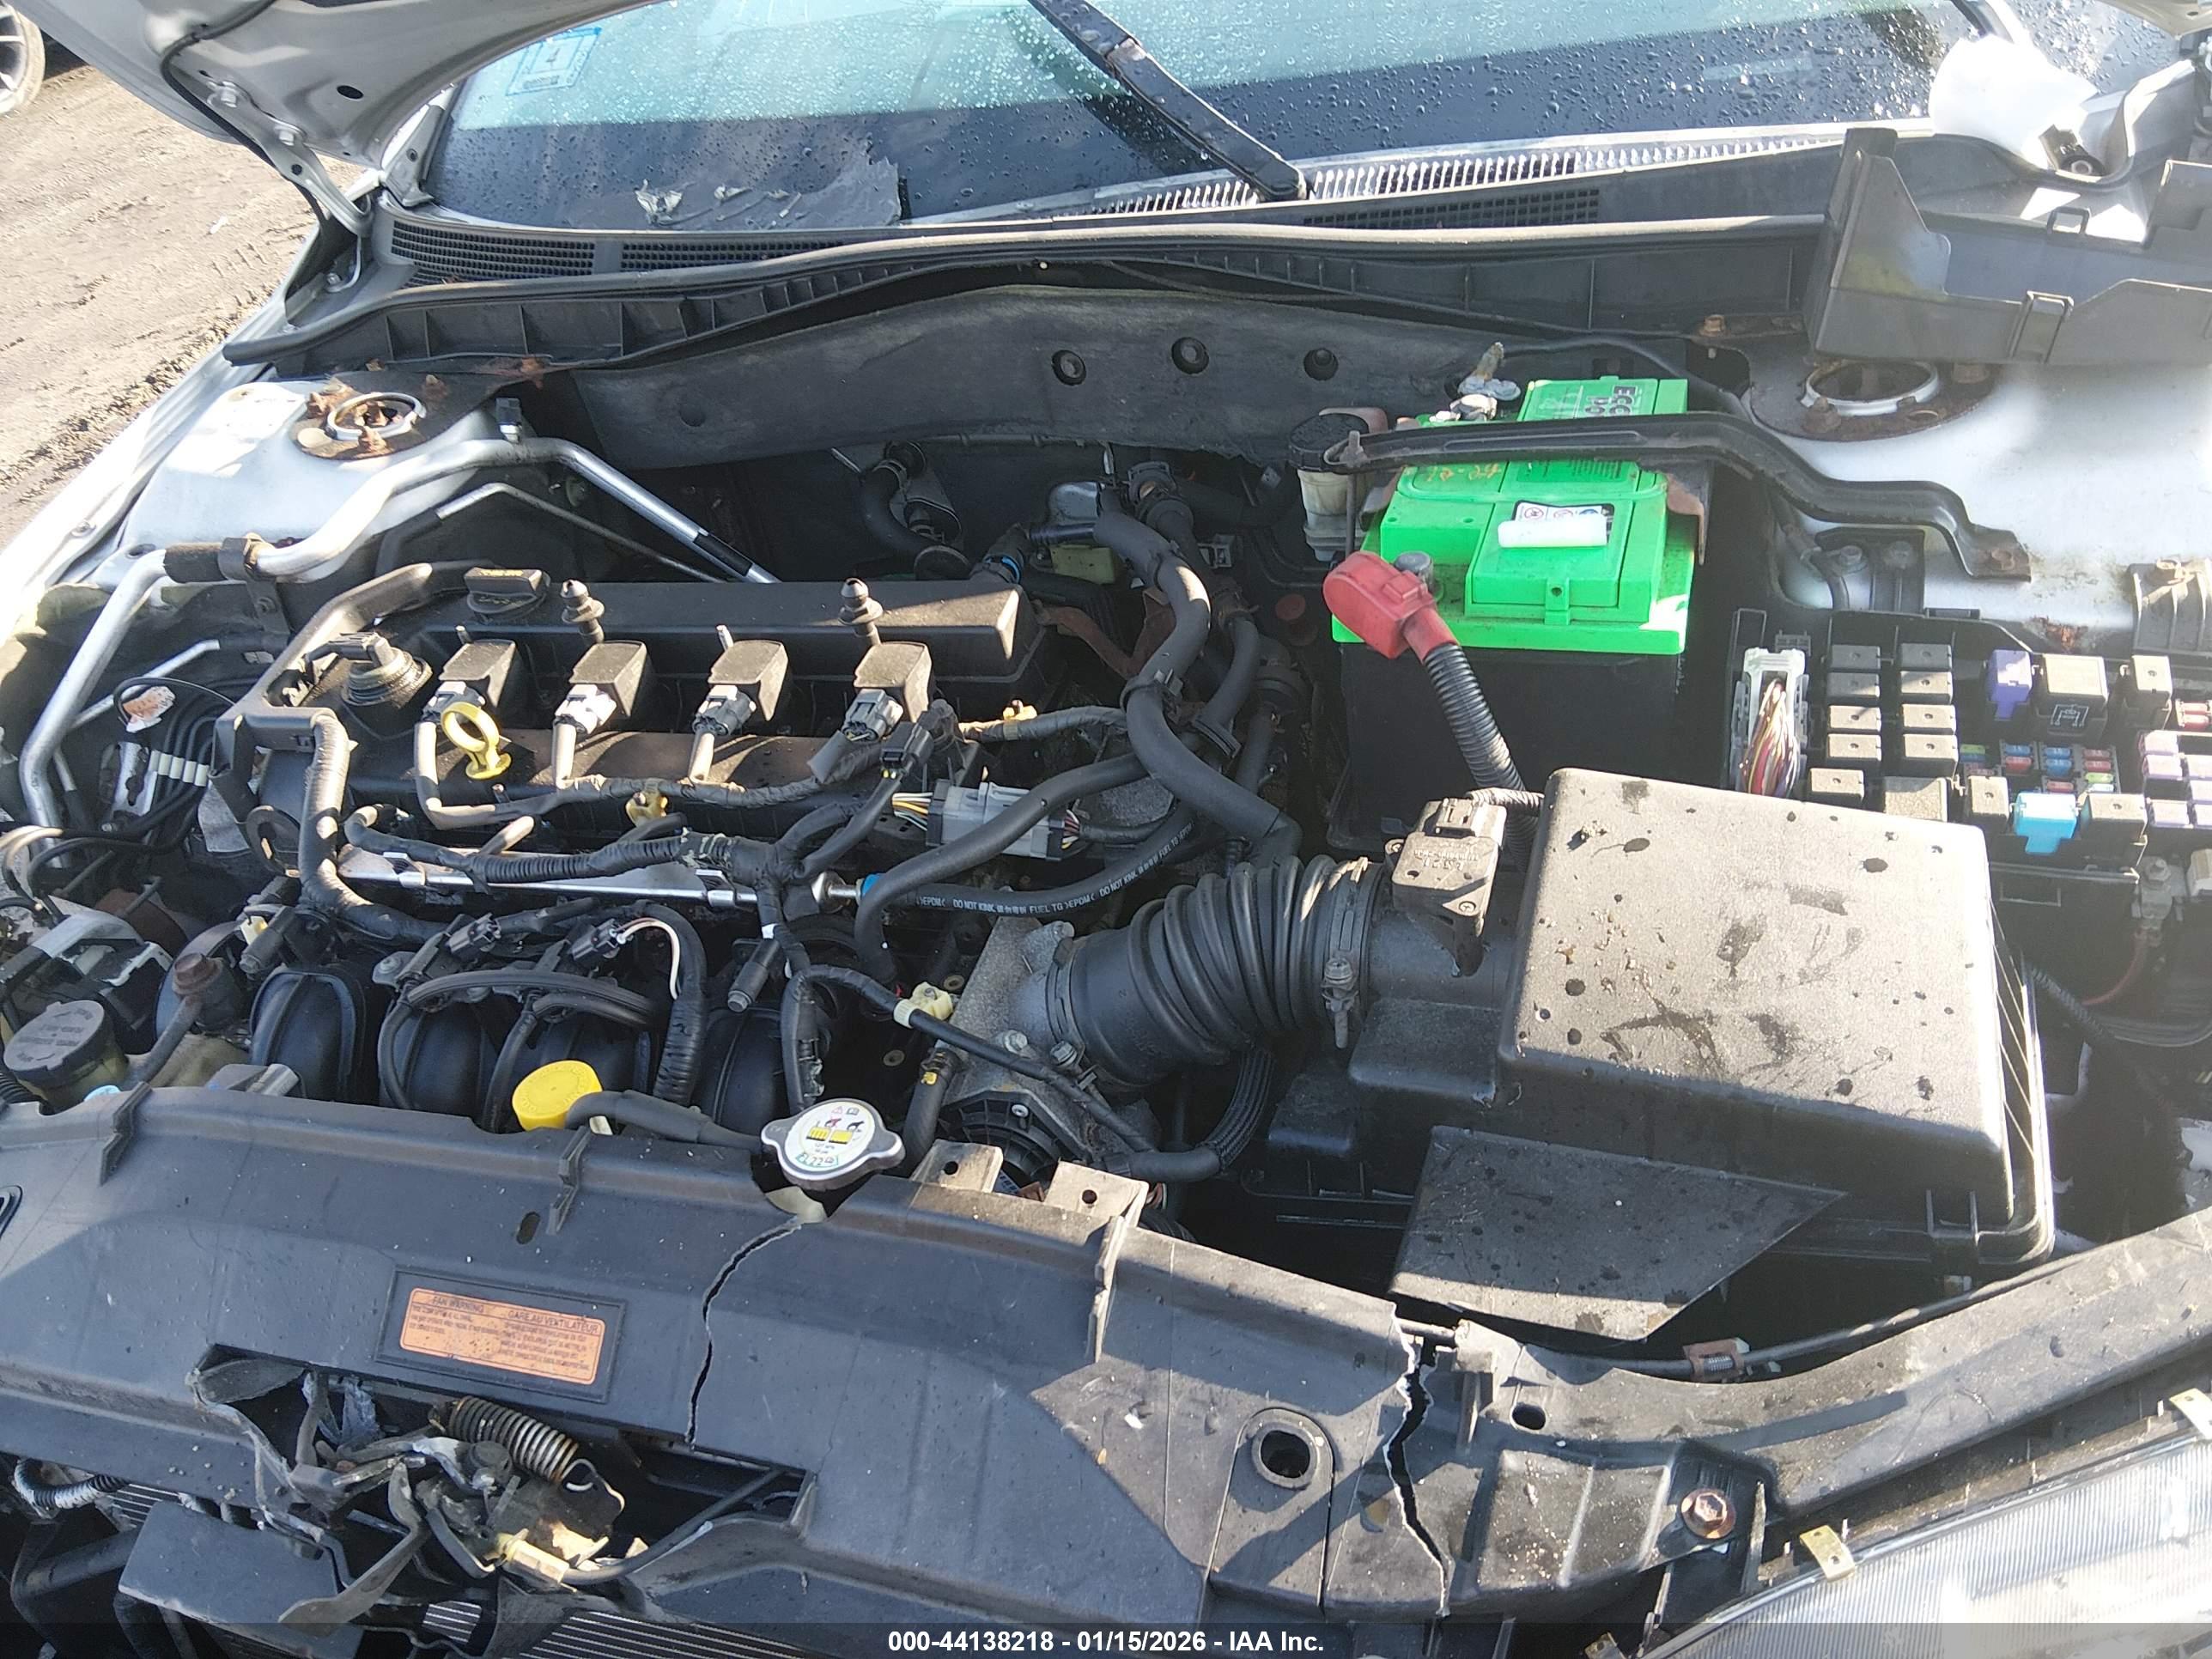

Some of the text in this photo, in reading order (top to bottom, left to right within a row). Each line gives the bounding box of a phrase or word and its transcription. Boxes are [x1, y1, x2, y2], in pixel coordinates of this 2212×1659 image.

[952, 898, 963, 908] DO
[963, 900, 978, 910] NOT
[1029, 904, 1051, 915] FUEL
[1051, 902, 1063, 913] TG
[1099, 885, 1110, 897] DO
[1110, 878, 1125, 892] NOT
[433, 1296, 484, 1314] FAN WARNING
[508, 1310, 599, 1334] GARE AU VENTILATEUR
